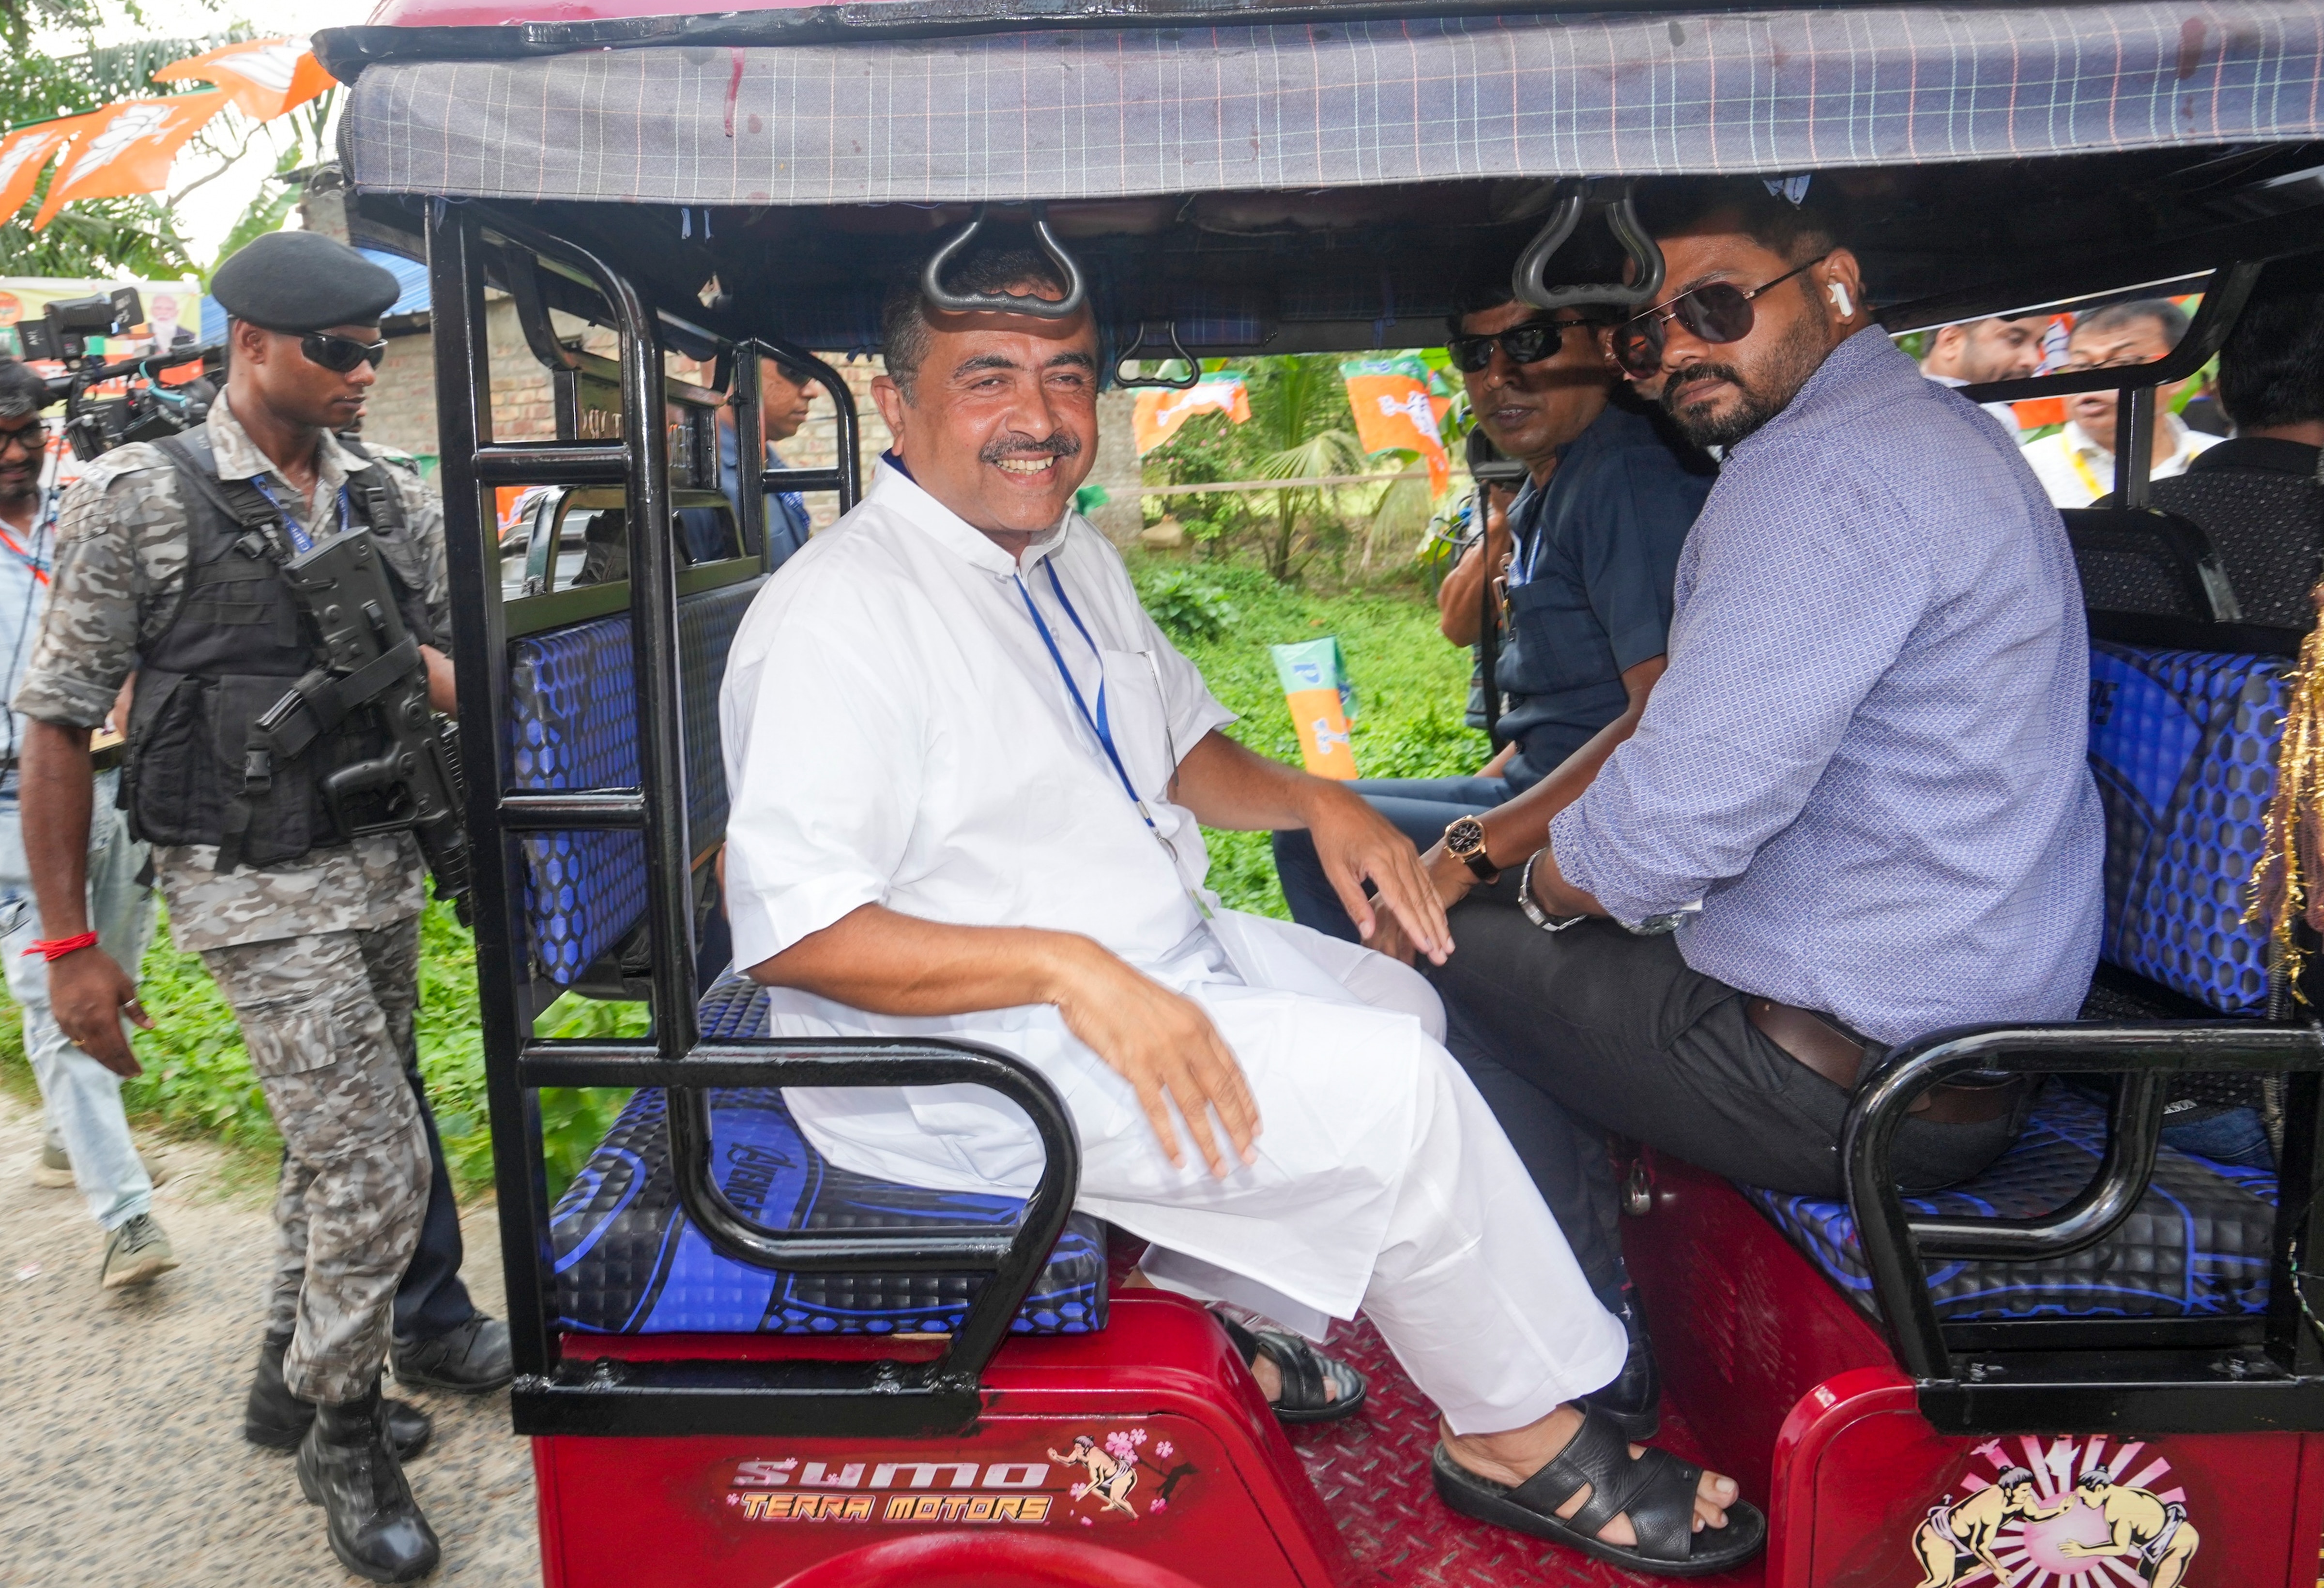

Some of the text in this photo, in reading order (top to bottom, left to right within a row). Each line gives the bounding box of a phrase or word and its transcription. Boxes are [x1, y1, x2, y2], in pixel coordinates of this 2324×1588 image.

[733, 1461, 1050, 1488] SUMO
[741, 1492, 1053, 1523] TERRA MOTORS
